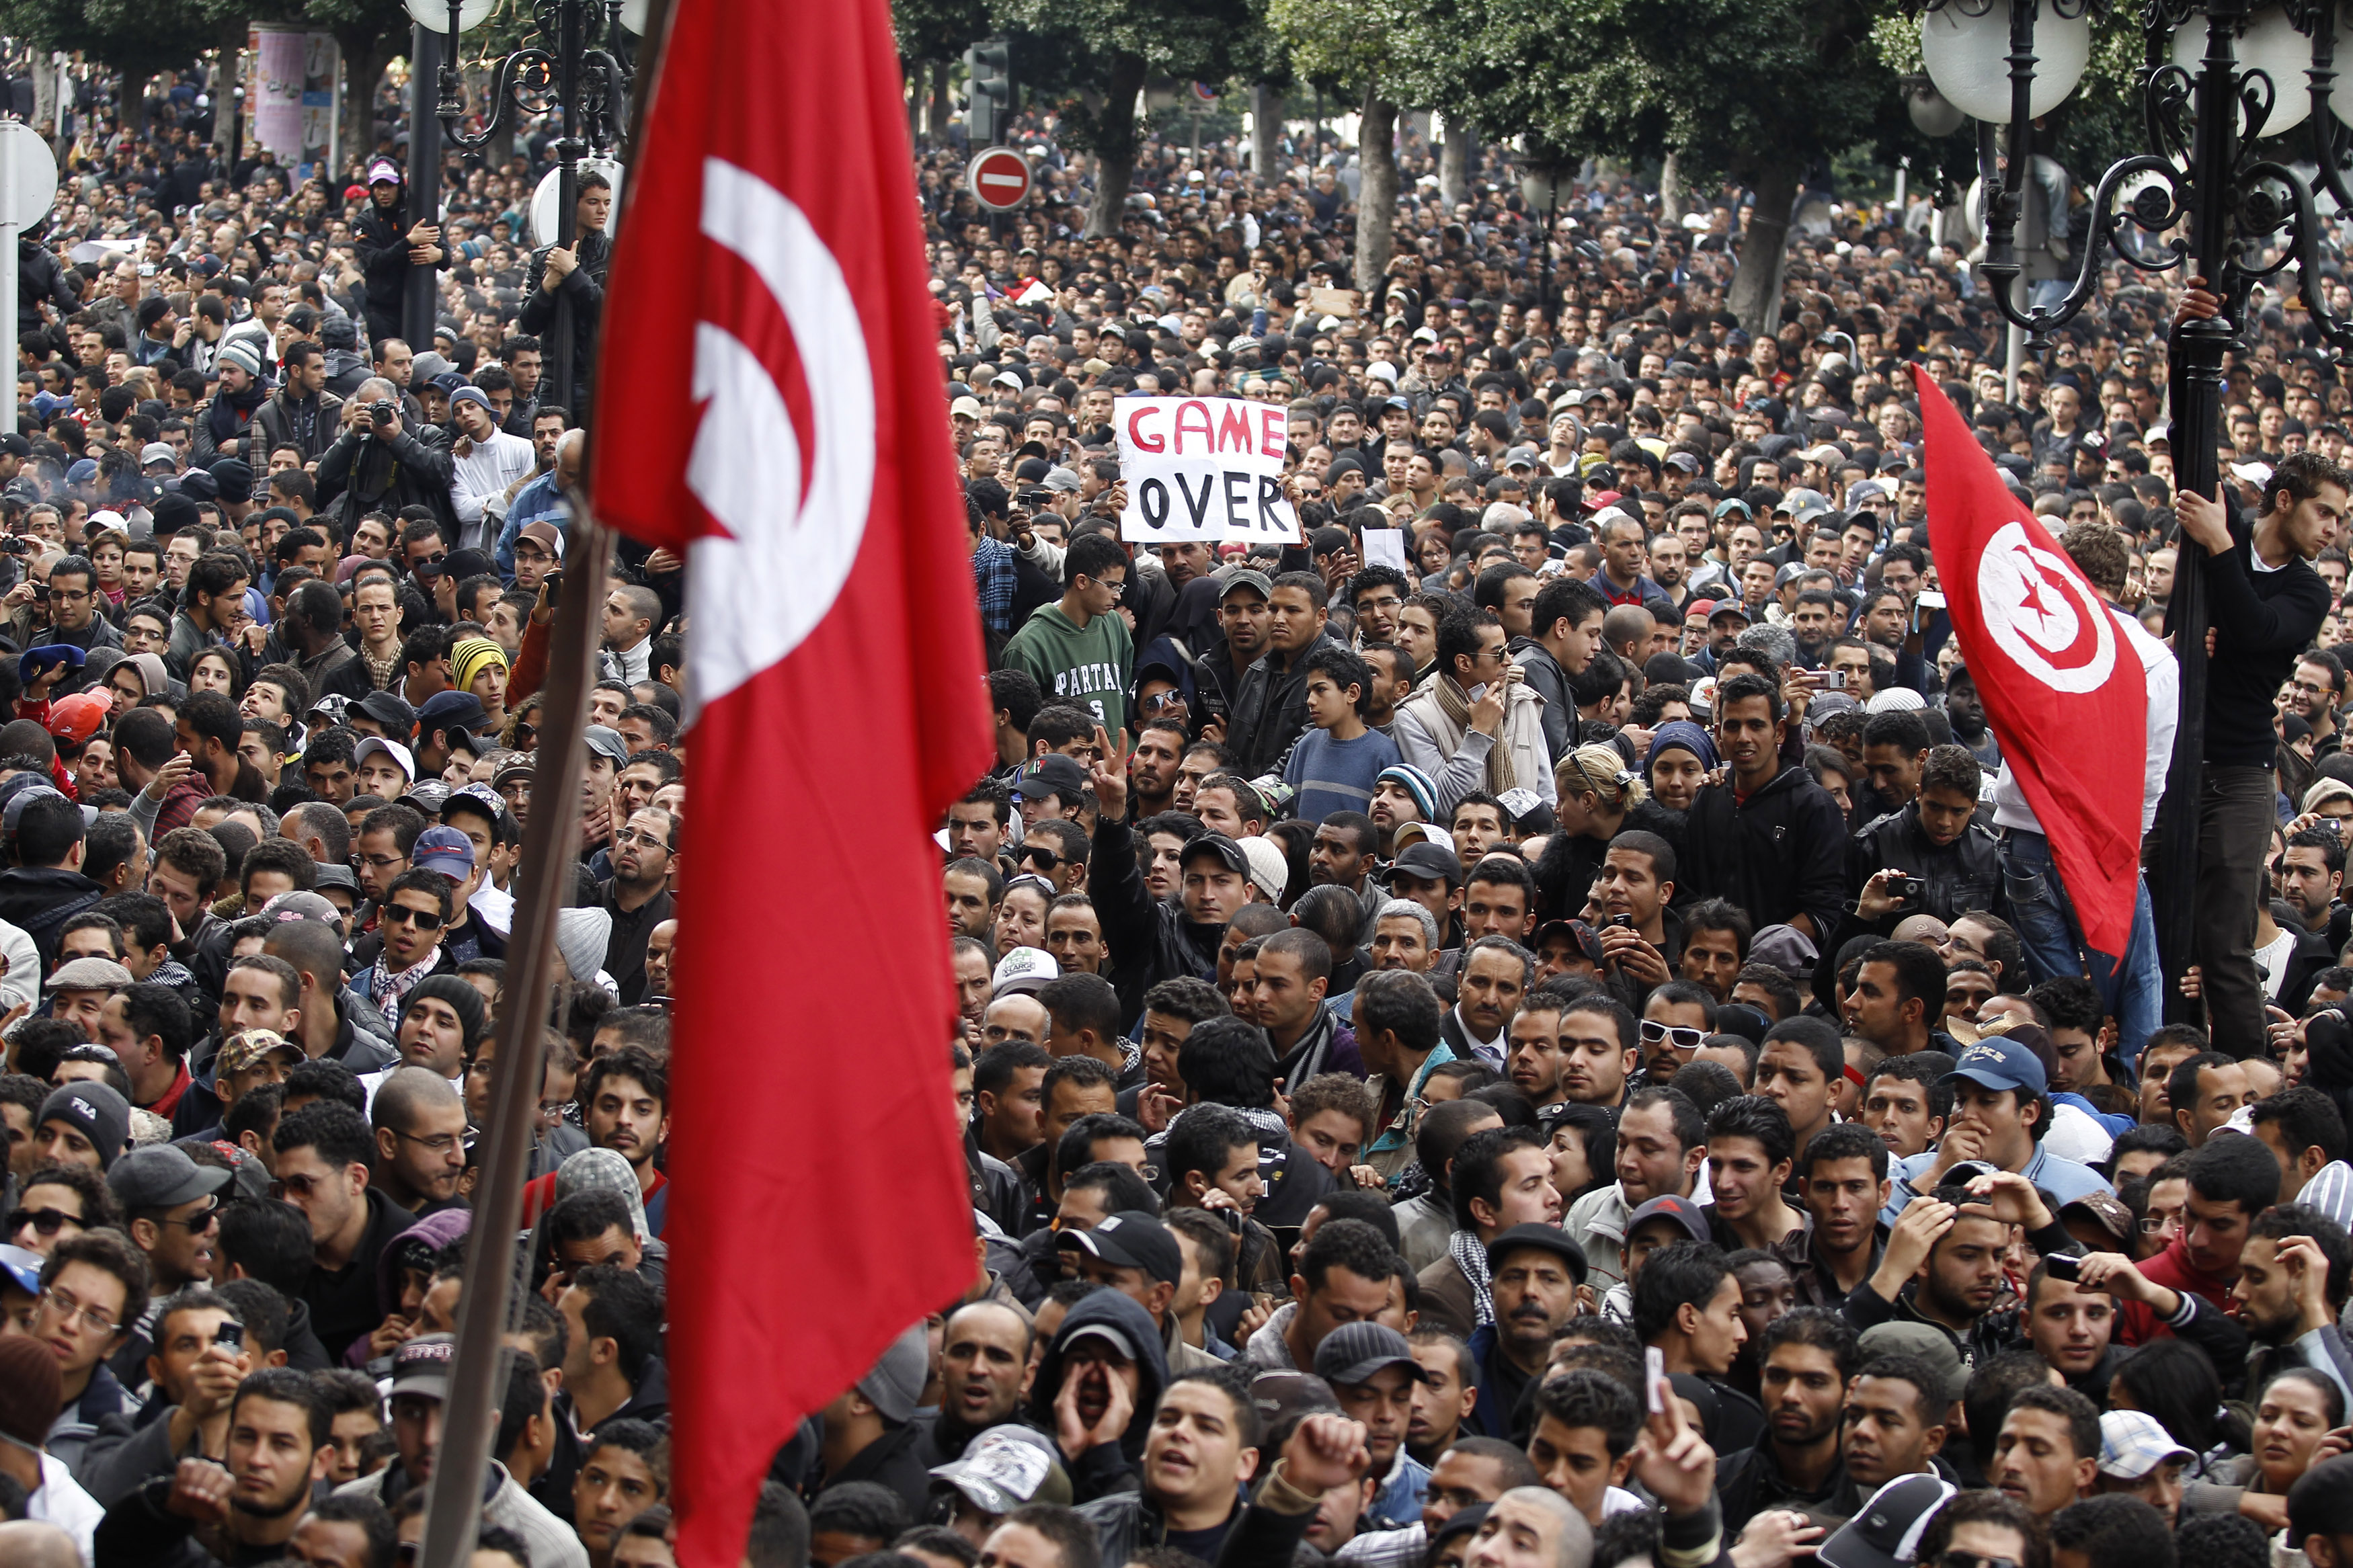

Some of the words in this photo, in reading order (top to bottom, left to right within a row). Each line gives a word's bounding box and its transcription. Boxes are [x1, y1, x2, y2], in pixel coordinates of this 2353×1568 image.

[1128, 400, 1285, 458] GAME
[1140, 471, 1289, 532] OVER
[1962, 1046, 2006, 1063] NIKE
[71, 1096, 97, 1120] FILA
